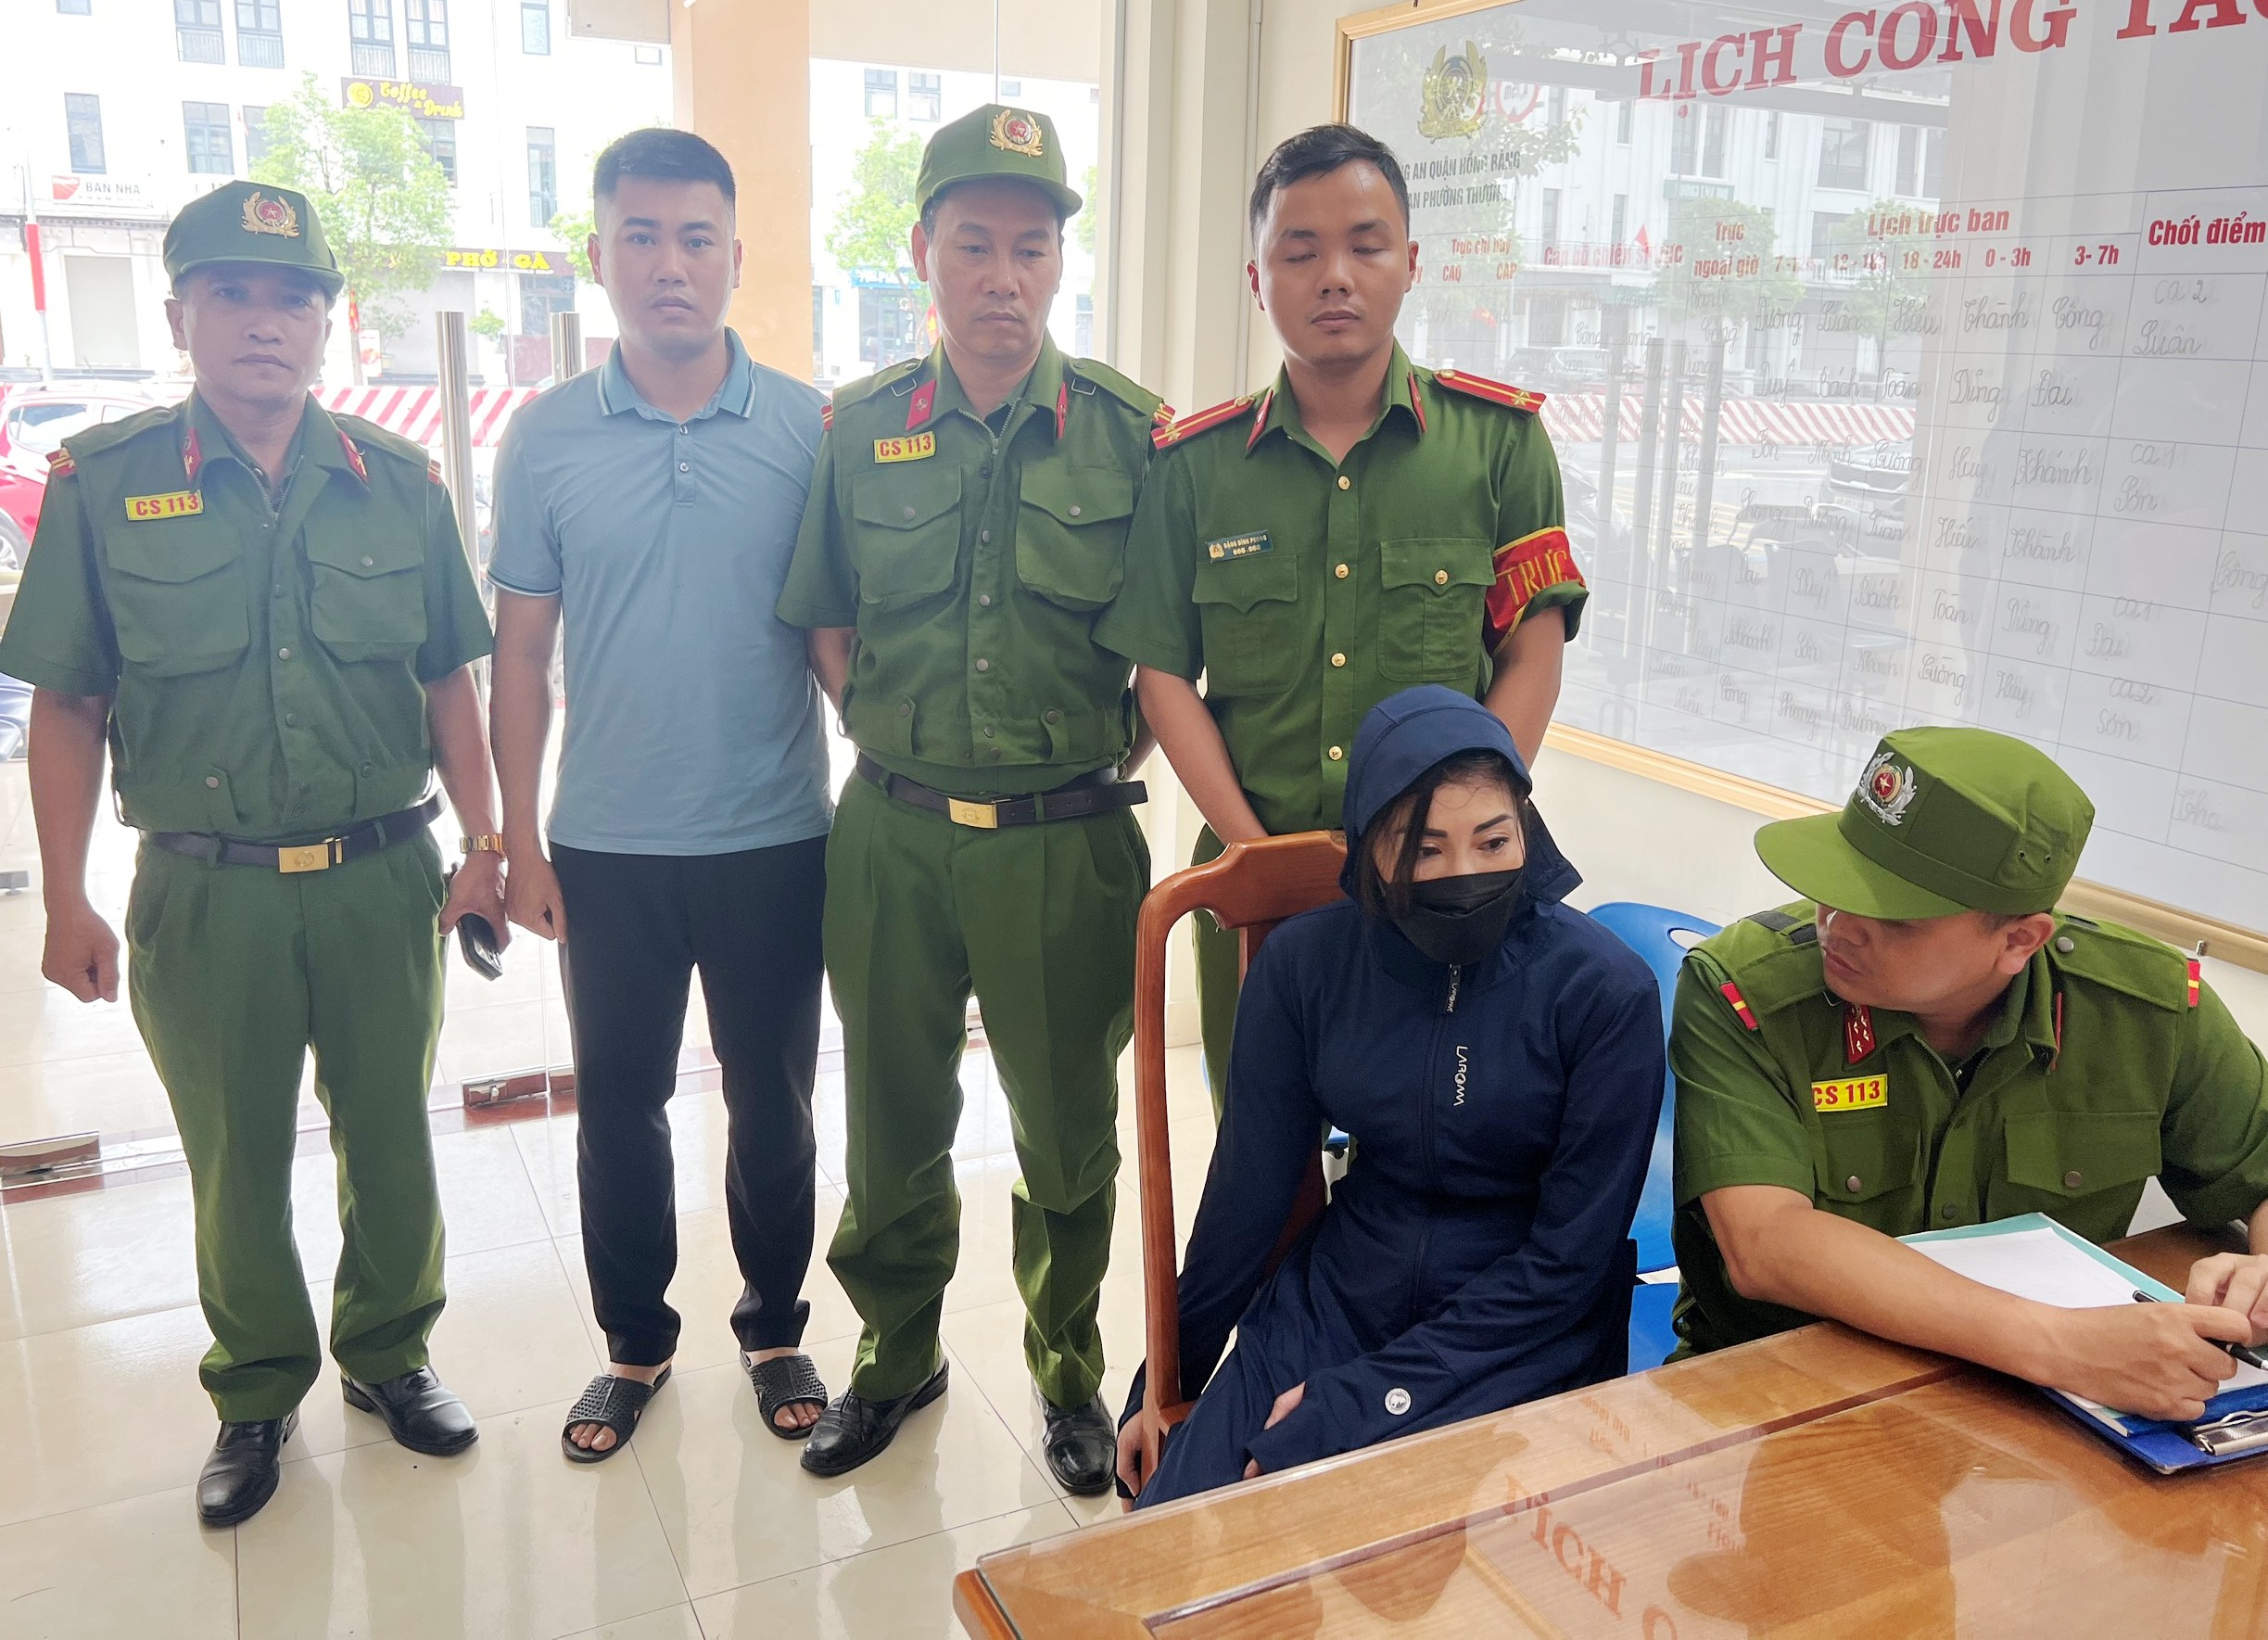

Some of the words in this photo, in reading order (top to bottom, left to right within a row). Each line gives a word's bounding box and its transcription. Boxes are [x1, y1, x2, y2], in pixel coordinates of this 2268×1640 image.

[1633, 23, 1802, 119] LỊCH
[1413, 161, 1426, 180] AN
[1429, 156, 1457, 181] QUẬN
[1716, 221, 1744, 245] Trực
[1868, 212, 1912, 240] Lịch
[1918, 210, 1961, 238] trực
[1967, 208, 2009, 232] ban
[2148, 214, 2199, 246] Chốt
[2206, 210, 2267, 244] điểm
[1451, 238, 1472, 259] Trực
[1985, 248, 1996, 267] 0
[2010, 248, 2031, 267] 3h
[2097, 245, 2119, 265] 7h
[513, 252, 551, 270] GÀ
[1903, 251, 1920, 269] 18
[1933, 250, 1961, 269] 24h
[1442, 264, 1462, 282] CAQ
[1496, 263, 1517, 280] CAP
[879, 439, 902, 456] CS
[906, 435, 931, 453] 113
[135, 500, 161, 516] CS
[166, 495, 198, 513] 113
[1812, 1086, 1838, 1106] CS
[1845, 1080, 1880, 1103] 113
